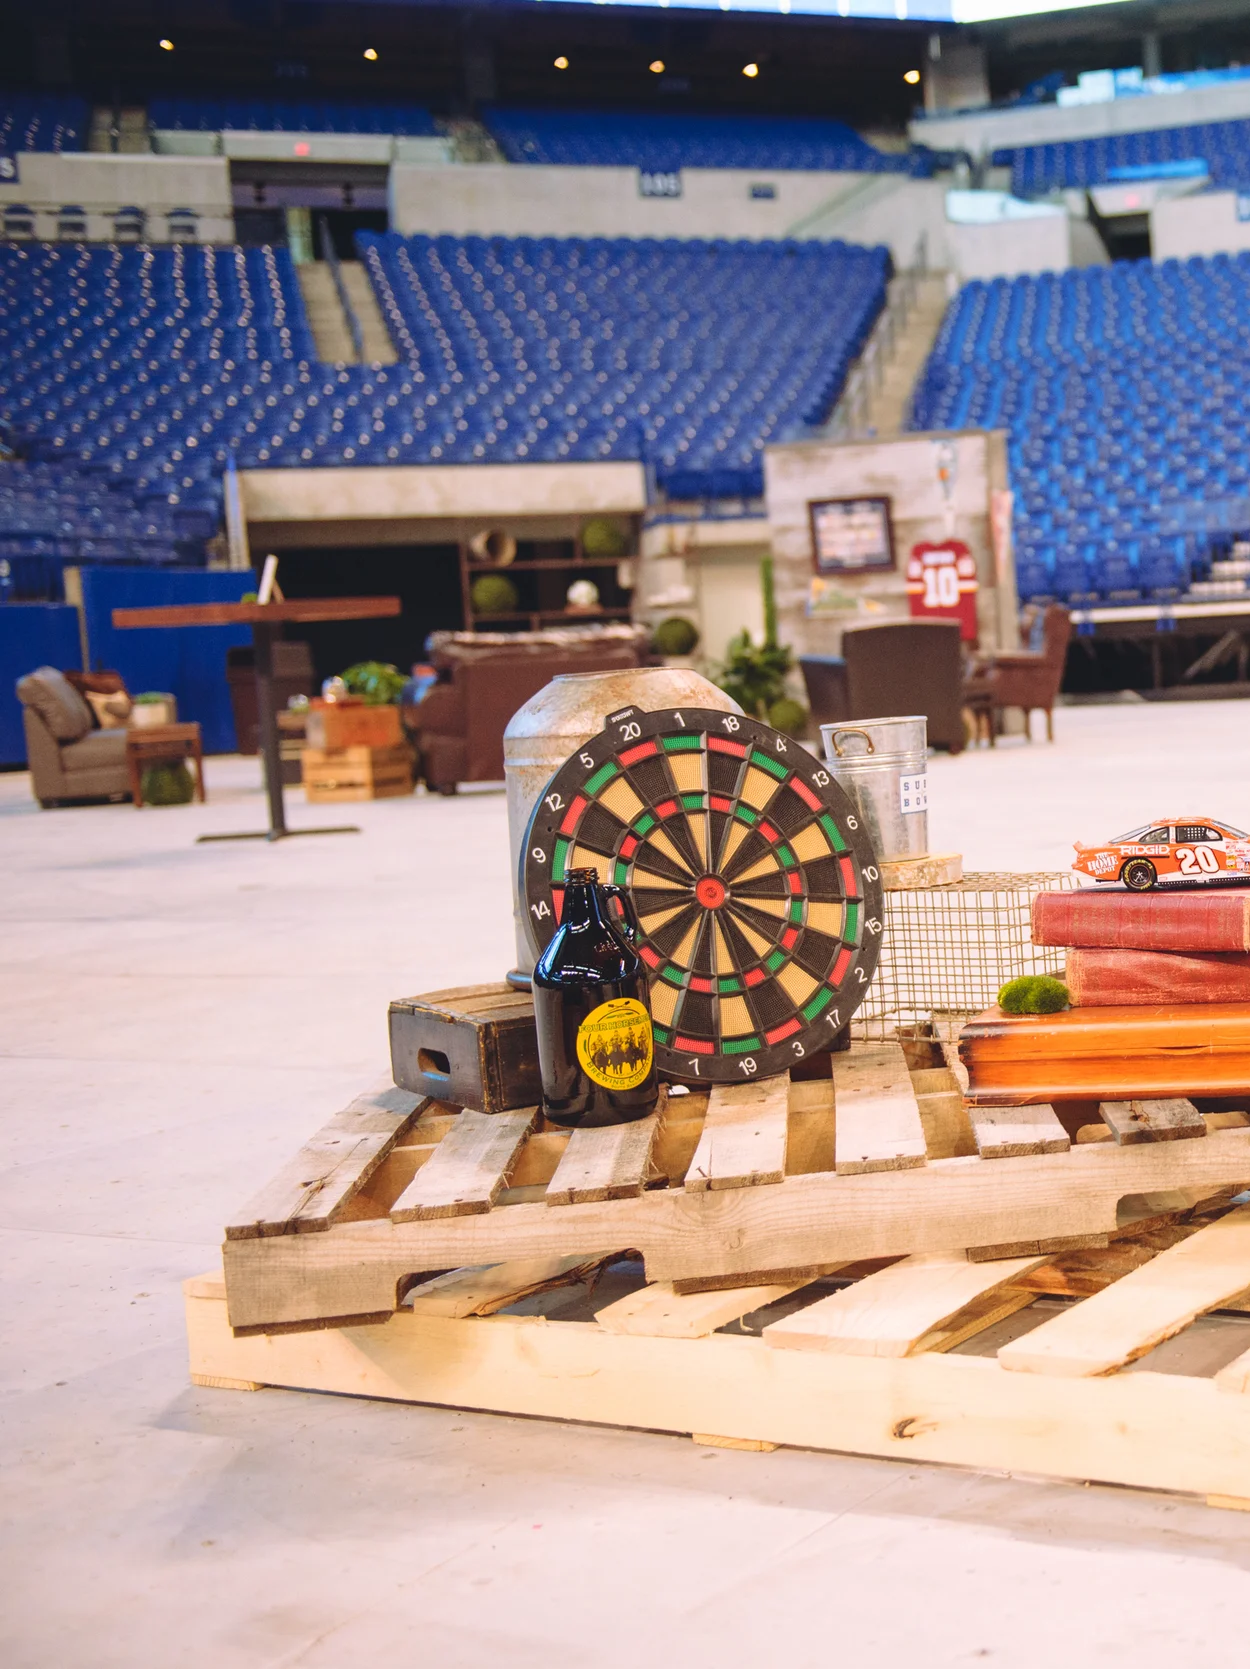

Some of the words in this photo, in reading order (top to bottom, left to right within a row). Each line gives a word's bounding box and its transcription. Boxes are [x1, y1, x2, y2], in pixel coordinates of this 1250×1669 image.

[922, 566, 961, 608] 10
[673, 712, 686, 728] 1
[722, 715, 740, 733] 18
[619, 721, 641, 742] 20
[776, 738, 788, 753] 4
[580, 752, 594, 768] 5
[811, 770, 830, 787] 13
[545, 793, 565, 812] 12
[847, 815, 858, 830] 6
[532, 847, 546, 863] 9
[1121, 844, 1170, 855] RIDGID
[1087, 855, 1118, 871] HOME
[1175, 845, 1220, 875] 20
[862, 866, 879, 882] 10
[1095, 866, 1116, 875] DEPOT
[531, 900, 552, 920] 14
[865, 917, 883, 935] 15
[855, 967, 868, 984] 2
[825, 1009, 841, 1027] 17
[578, 1022, 608, 1034] FOUR
[793, 1041, 805, 1058] 3
[586, 1061, 625, 1086] BREWING
[688, 1059, 701, 1077] 7
[739, 1056, 757, 1075] 19
